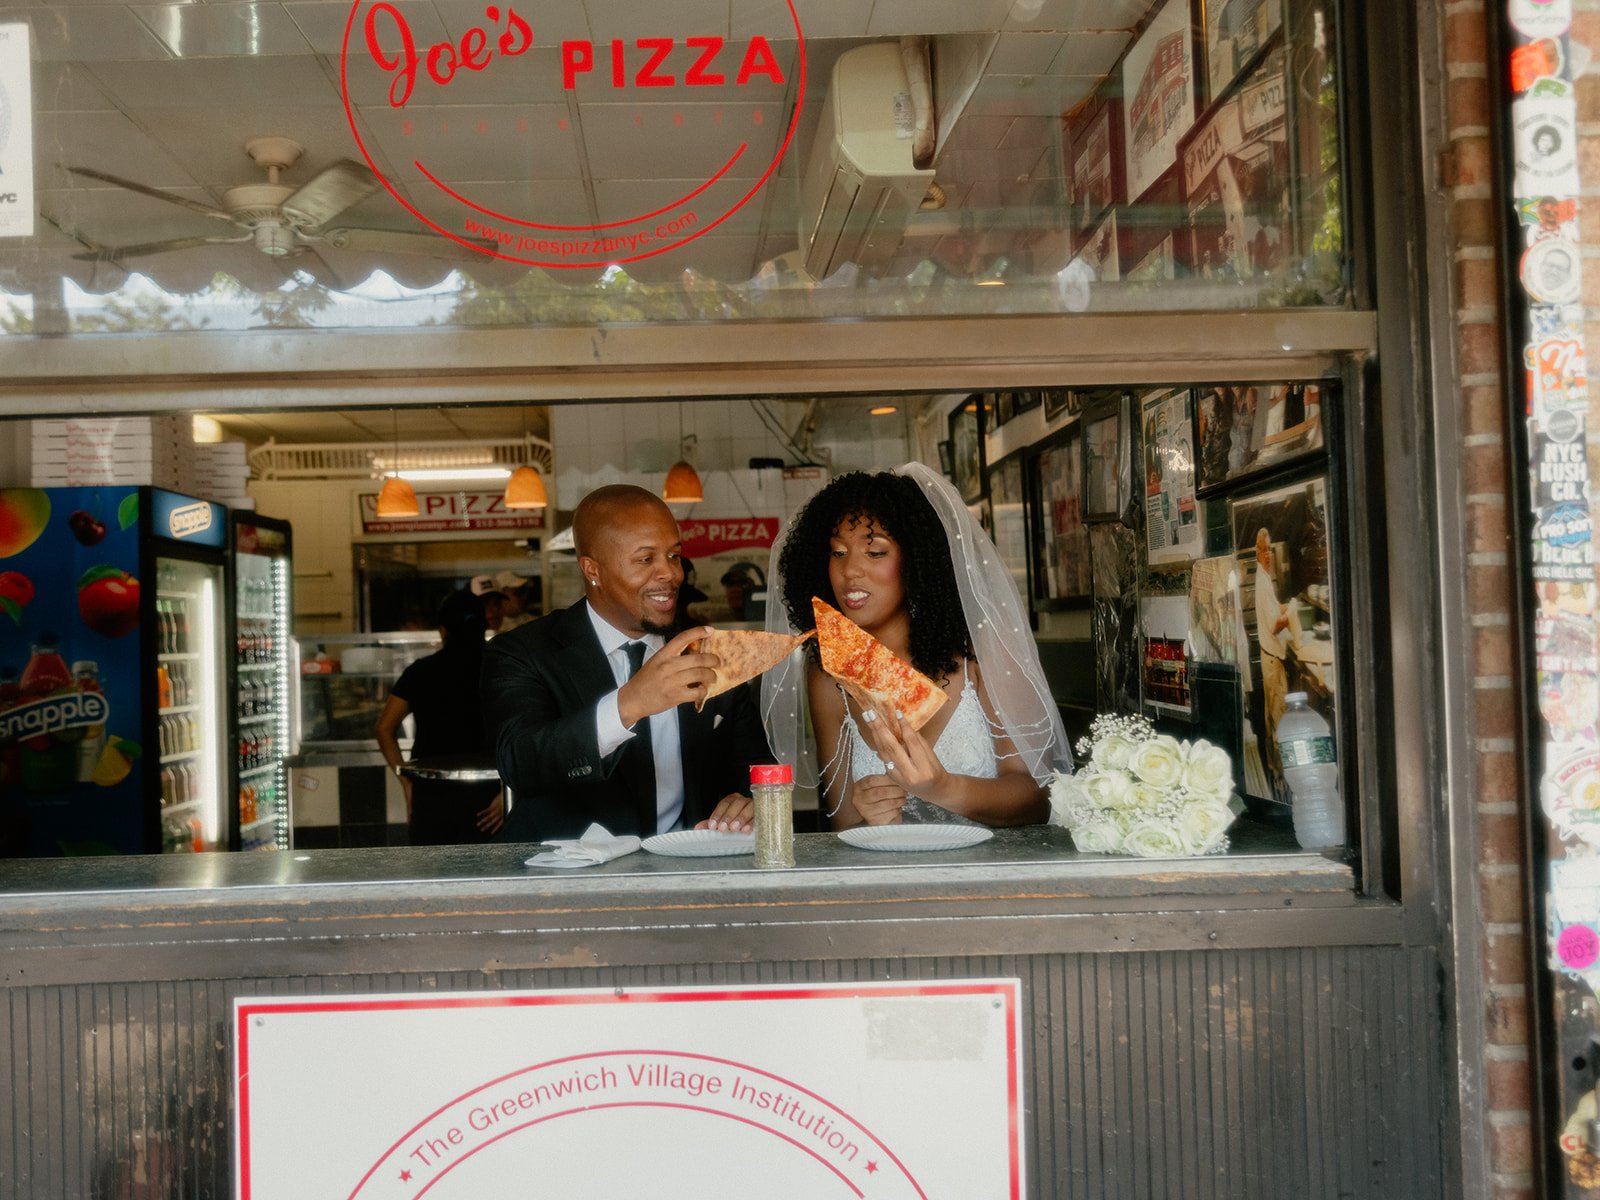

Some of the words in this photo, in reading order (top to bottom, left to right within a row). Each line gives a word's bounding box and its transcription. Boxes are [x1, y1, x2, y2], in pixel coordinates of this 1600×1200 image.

[364, 2, 533, 109] Joe's
[561, 35, 785, 90] PIZZA
[1196, 125, 1222, 173] PIZZA
[464, 210, 698, 257] www.joespizzanyc.com
[1540, 462, 1587, 482] KUSH
[1544, 443, 1583, 462] NYC
[426, 495, 537, 515] PIZZ
[708, 523, 770, 541] PIZZA
[0, 694, 101, 738] snapple
[409, 1127, 464, 1168] The
[467, 1065, 618, 1131] Greenwich
[627, 1063, 722, 1098] Village
[731, 1076, 860, 1163] Institution
